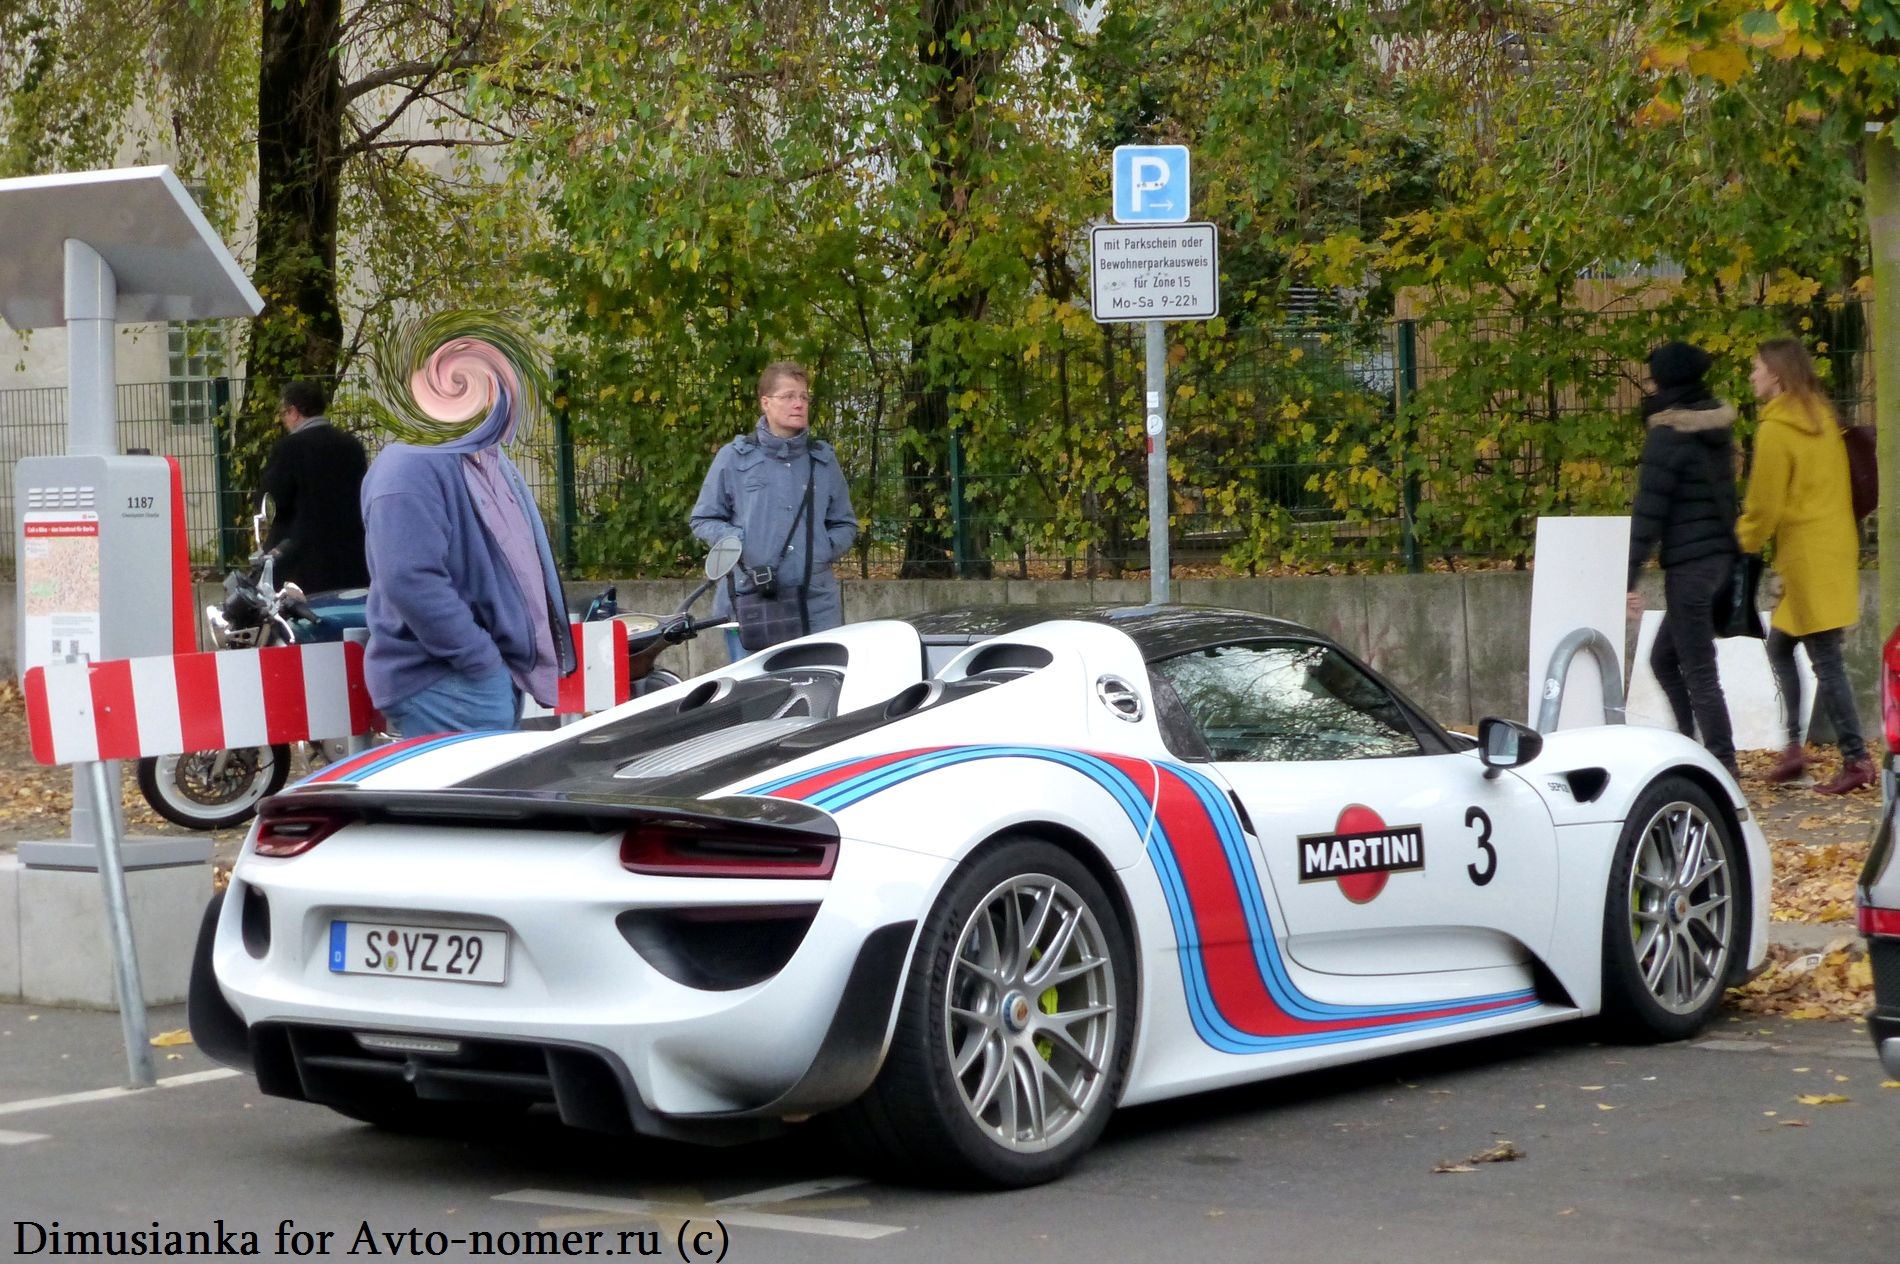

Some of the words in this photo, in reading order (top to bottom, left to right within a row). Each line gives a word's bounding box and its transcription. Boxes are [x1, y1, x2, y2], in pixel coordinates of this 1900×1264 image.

[1131, 156, 1170, 212] P
[1104, 239, 1120, 250] mit
[1124, 237, 1177, 250] Parkschein
[1181, 236, 1204, 248] oder
[1100, 256, 1208, 271] Bewohnerparkausweis
[1134, 275, 1147, 288] für
[1153, 276, 1175, 288] Zone
[1178, 275, 1191, 288] 15
[1112, 296, 1154, 309] Mo-Sa
[127, 496, 154, 509] 1187
[1464, 805, 1498, 886] 3
[1305, 833, 1418, 874] MARTINI
[365, 930, 382, 968] S
[403, 932, 439, 972] YZ
[446, 935, 483, 974] 29
